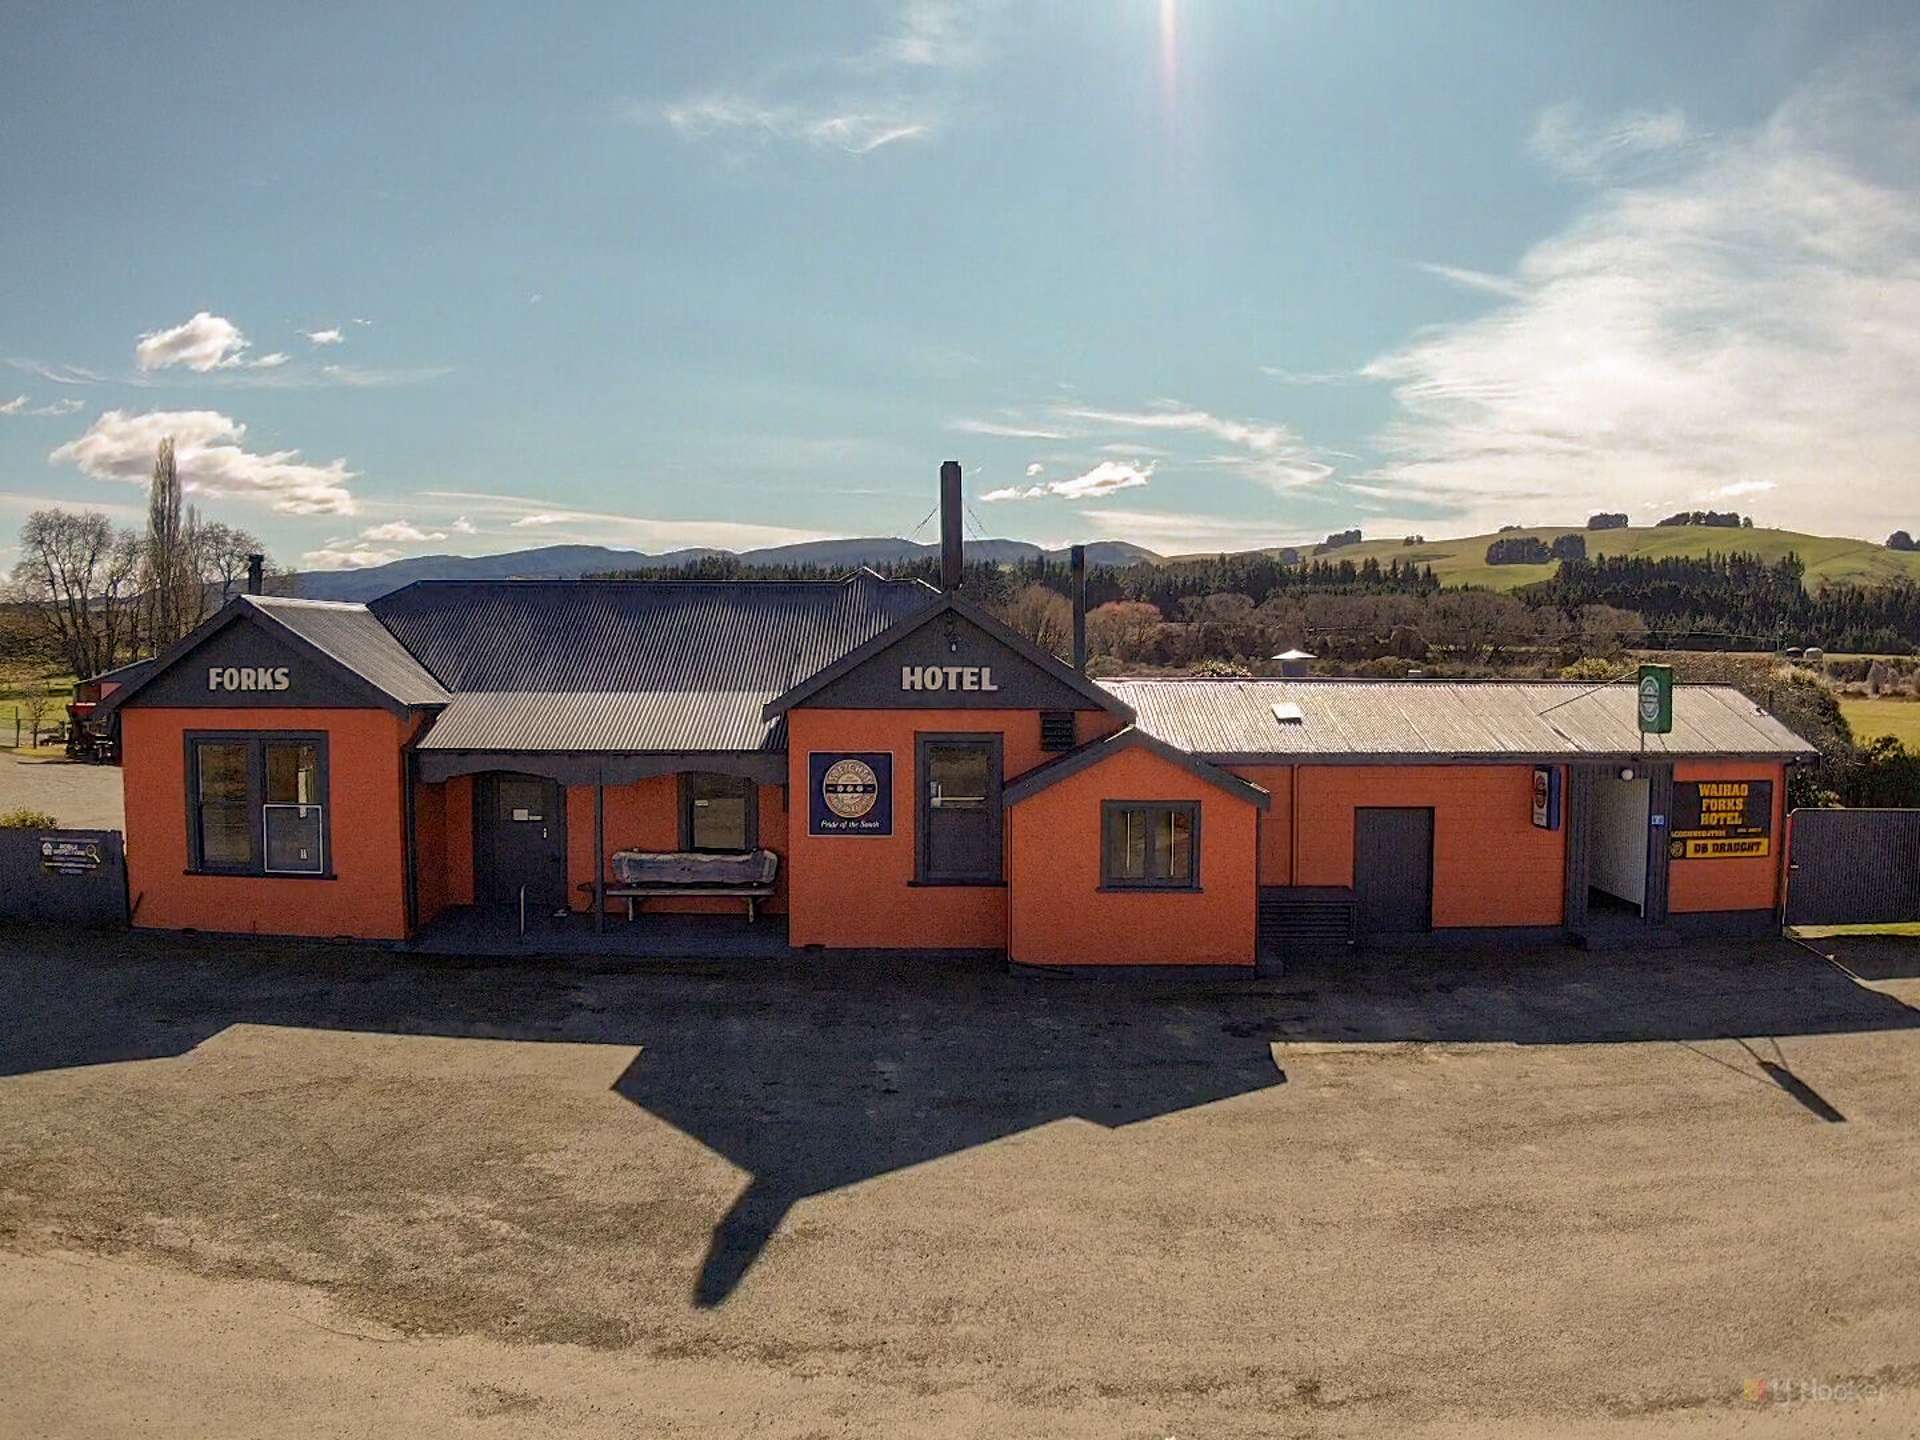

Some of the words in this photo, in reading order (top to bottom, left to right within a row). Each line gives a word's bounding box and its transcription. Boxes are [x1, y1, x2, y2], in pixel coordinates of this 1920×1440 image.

[208, 667, 290, 691] FORKS
[902, 666, 998, 690] HOTEL
[1699, 783, 1749, 796] WAIHAO
[1702, 799, 1743, 811] FORKS
[1701, 812, 1742, 825] HOTEL
[1694, 843, 1708, 853] DB
[1712, 841, 1762, 853] DRAUGHT
